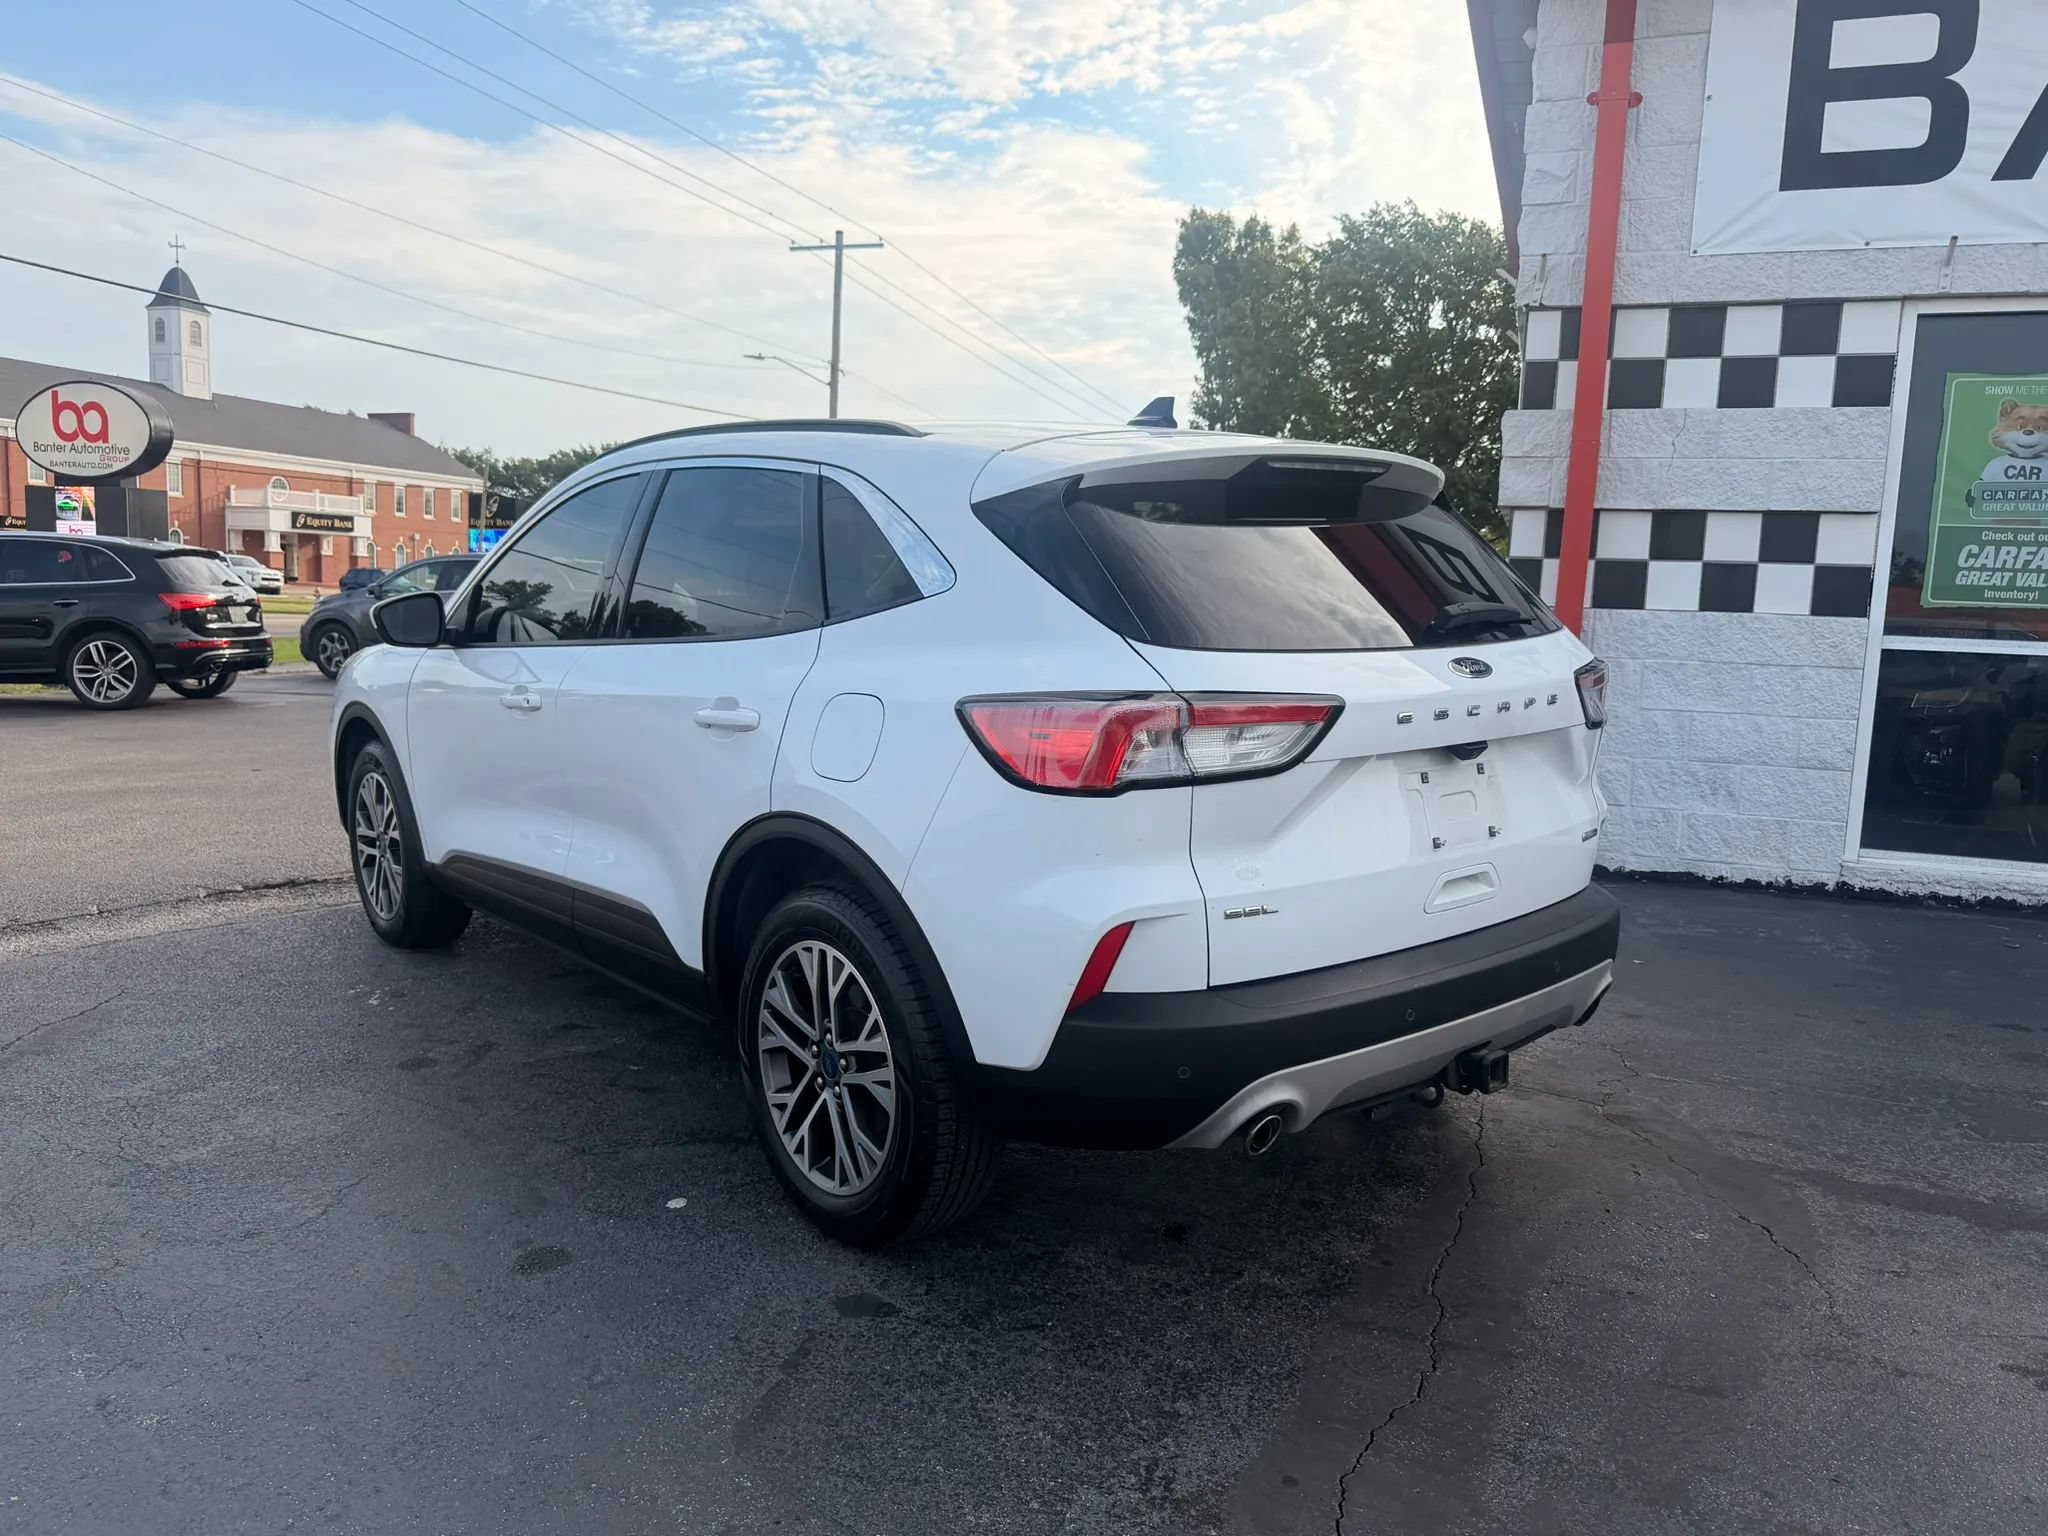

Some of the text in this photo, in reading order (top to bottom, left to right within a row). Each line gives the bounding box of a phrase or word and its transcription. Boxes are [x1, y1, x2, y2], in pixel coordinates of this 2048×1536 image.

[1985, 385, 2013, 395] SHOW
[2015, 385, 2029, 395] ME
[51, 389, 109, 444] ba
[33, 441, 130, 456] Banter Automotive
[49, 460, 113, 470] BANTERAUTO.COM
[99, 454, 130, 464] GROUP
[2003, 465, 2043, 480] CAR
[1982, 502, 2015, 512] GREAT
[306, 516, 353, 529] EQUITY BANK
[470, 517, 495, 527] EQTY
[1982, 530, 2015, 541] Check
[2017, 532, 2035, 542] out
[1955, 570, 2048, 588] GREAT VAL
[1984, 589, 2039, 602] Inventory!
[1460, 659, 1487, 672] Ford
[1397, 693, 1558, 724] ESCAPE
[1223, 905, 1279, 920] SEL
